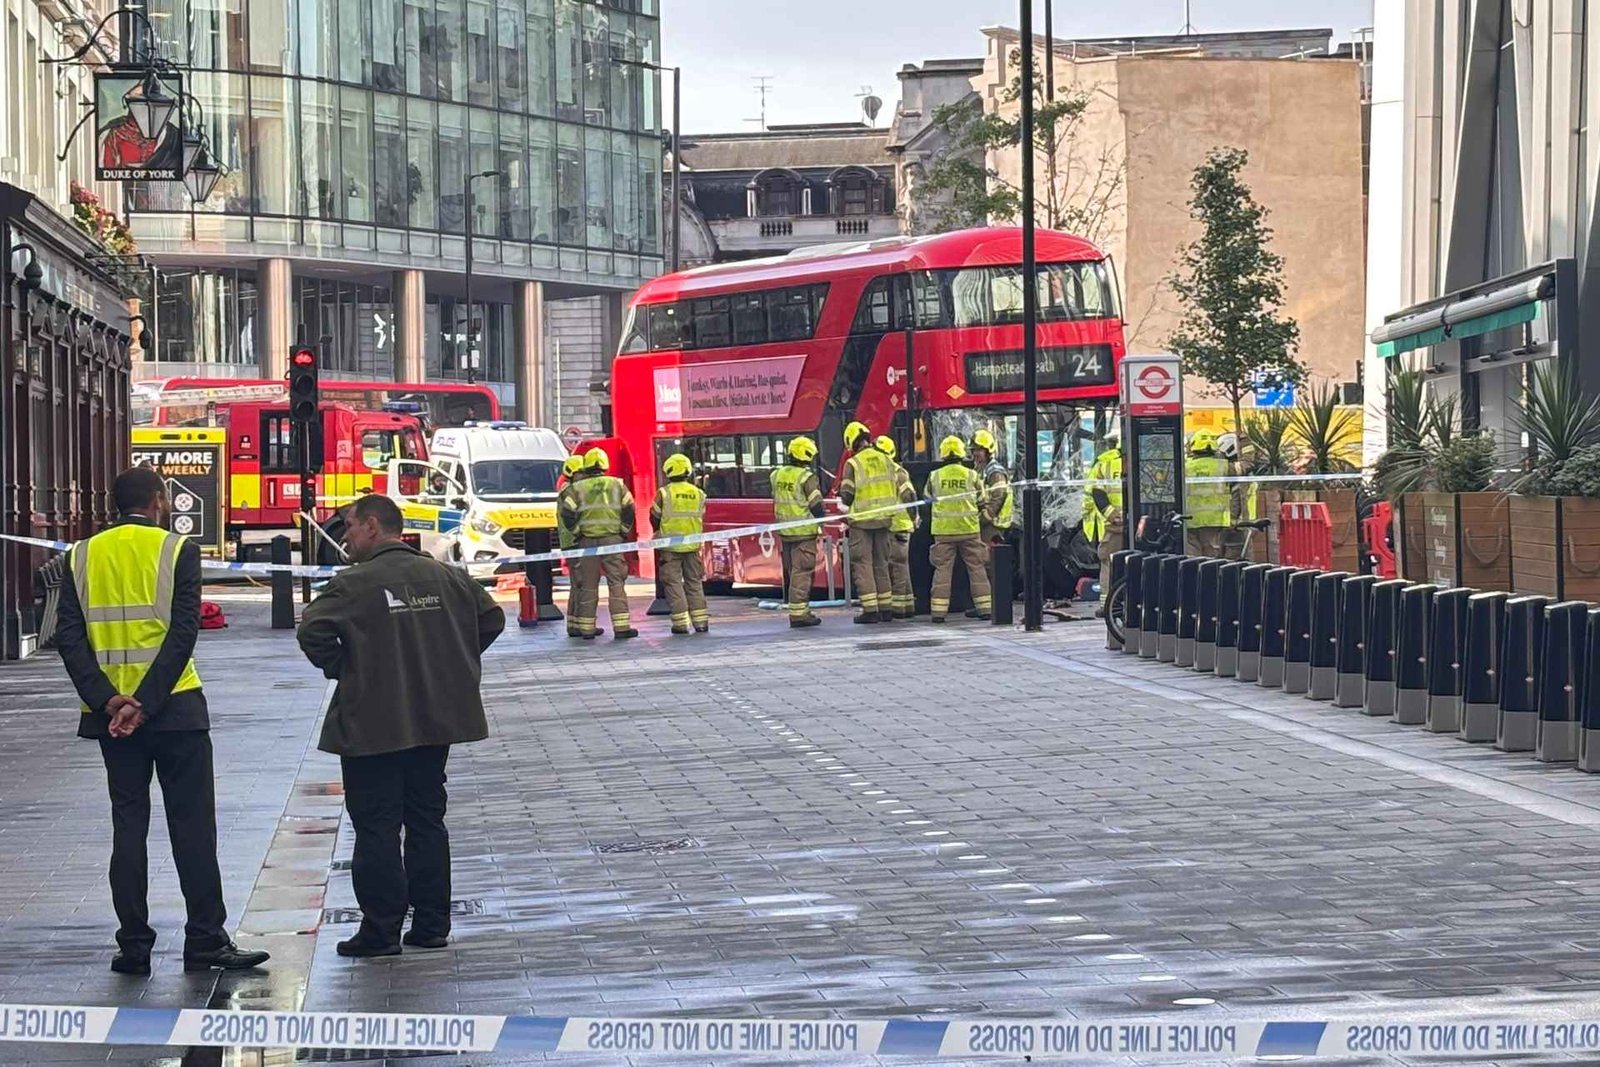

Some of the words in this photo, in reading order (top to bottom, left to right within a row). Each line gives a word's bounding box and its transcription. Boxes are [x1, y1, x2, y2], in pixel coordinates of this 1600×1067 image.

[103, 169, 131, 179] DUKE
[132, 169, 147, 179] OF
[148, 169, 176, 179] YORK
[975, 360, 1025, 380] Hampstead
[1036, 357, 1055, 373] eath
[1072, 353, 1102, 377] 24
[131, 451, 162, 467] GET
[164, 451, 213, 465] MORE
[161, 465, 212, 475] WEEKLY
[941, 479, 967, 489] FIRE
[509, 511, 555, 519] POLIC
